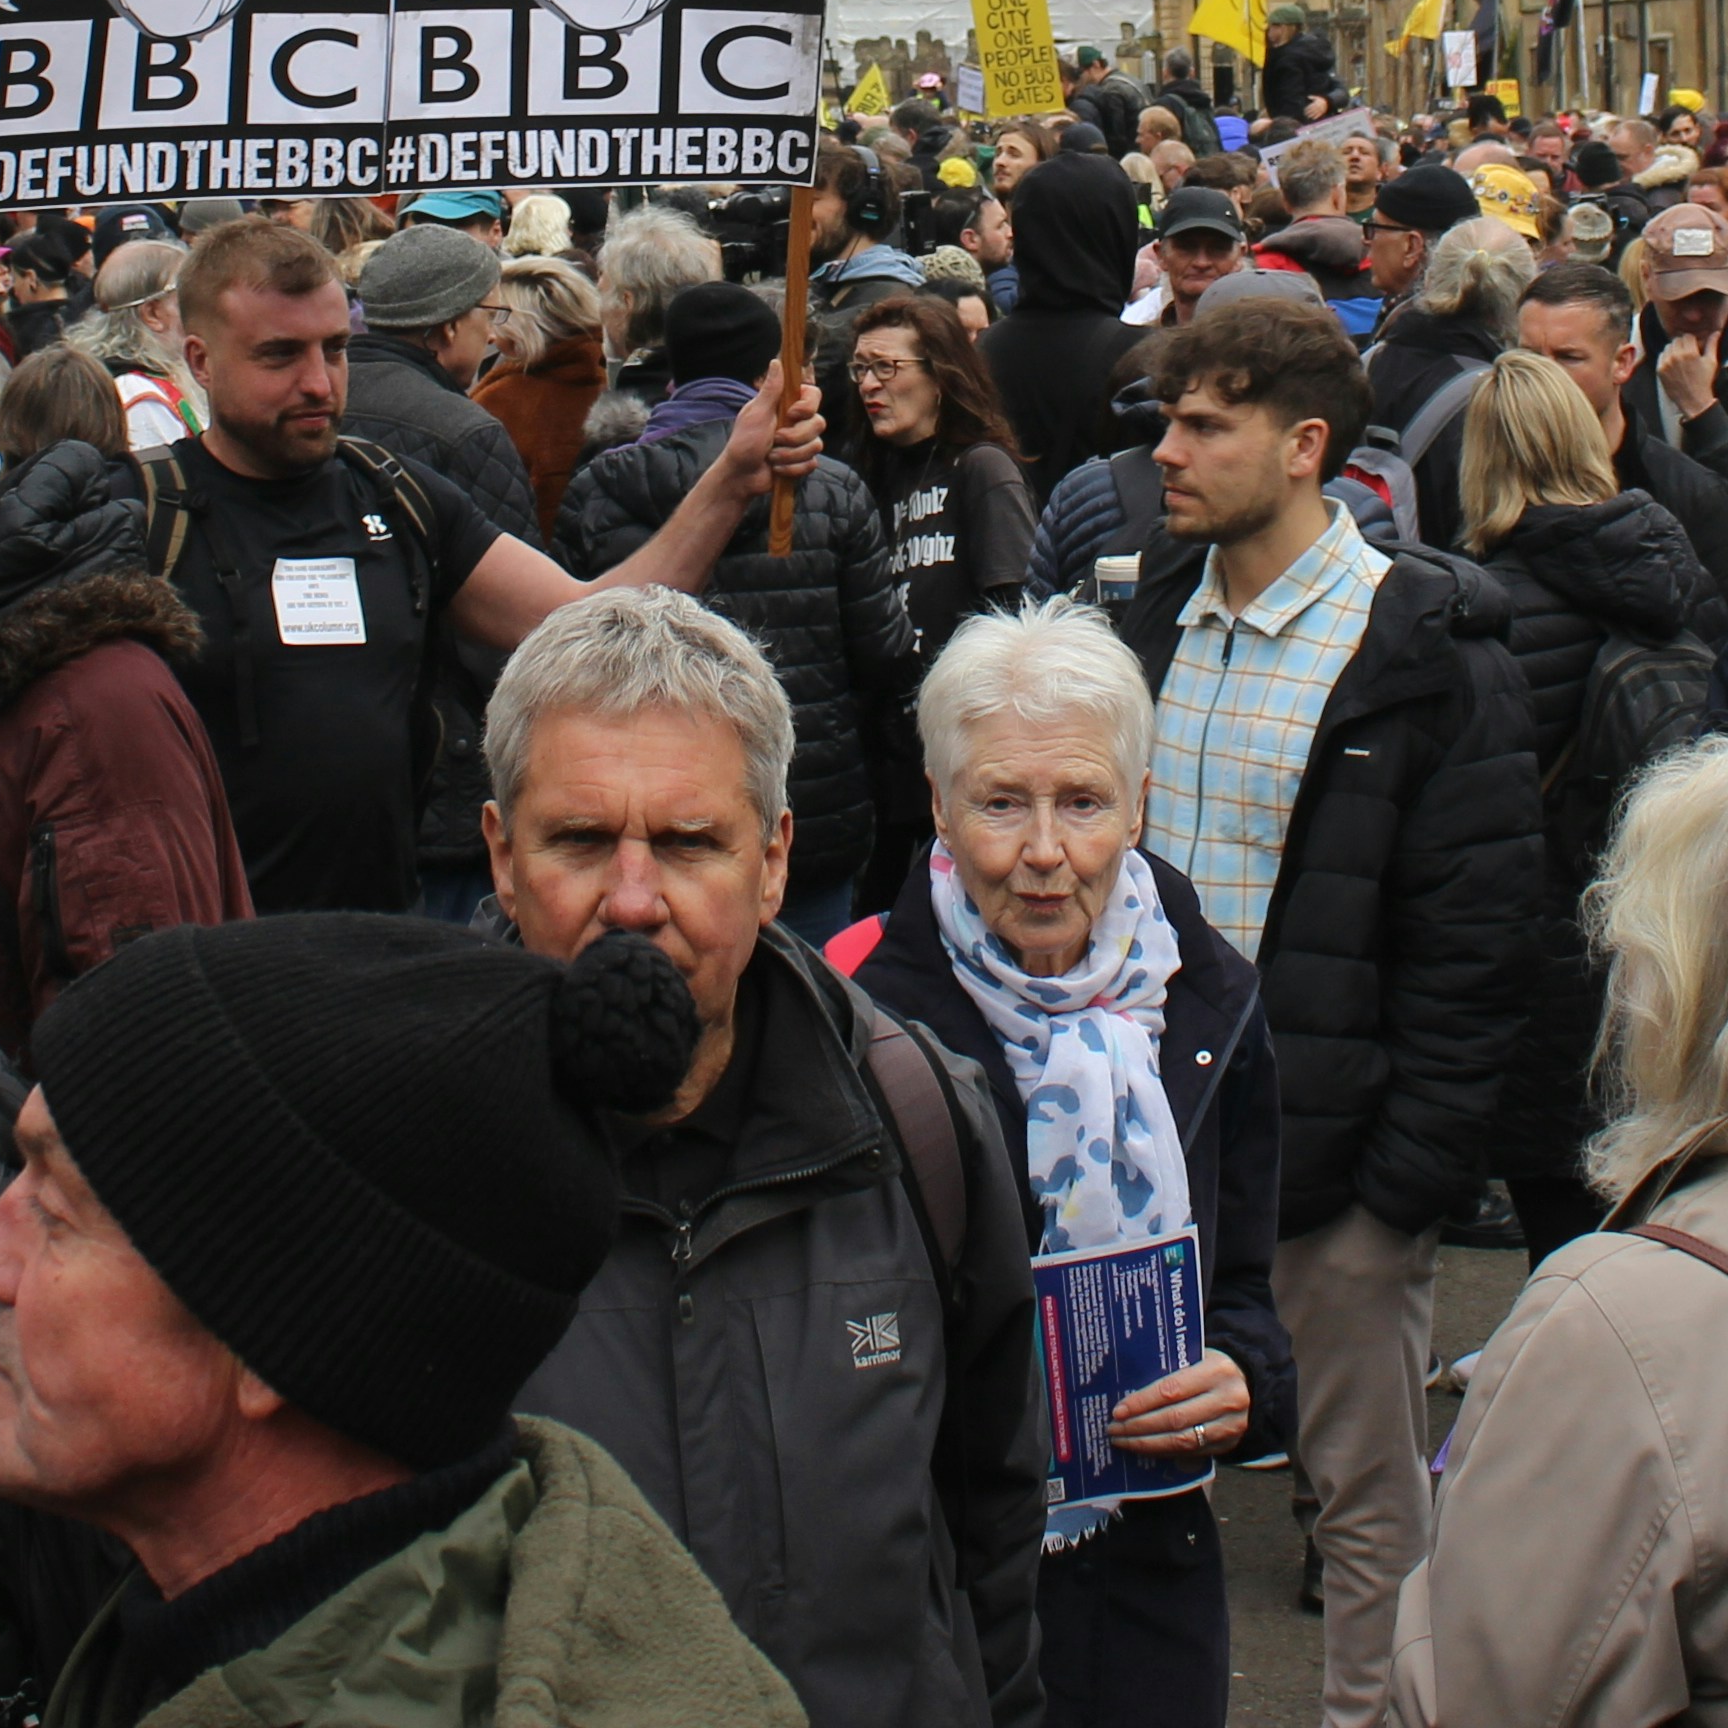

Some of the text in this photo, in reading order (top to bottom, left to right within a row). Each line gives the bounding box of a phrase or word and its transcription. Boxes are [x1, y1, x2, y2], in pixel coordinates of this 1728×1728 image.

[986, 8, 1030, 30] CITY
[994, 28, 1033, 49] ONE
[420, 25, 791, 103] BBC
[994, 65, 1055, 88] NO BUS
[1002, 85, 1055, 106] GATES
[387, 127, 810, 183] #DEFUNDTHEBBC
[283, 621, 359, 634] www.ukcolumn.org
[1169, 1267, 1184, 1307] What
[1172, 1307, 1186, 1326] do
[853, 1349, 901, 1368] karrimor
[1175, 1332, 1189, 1368] need
